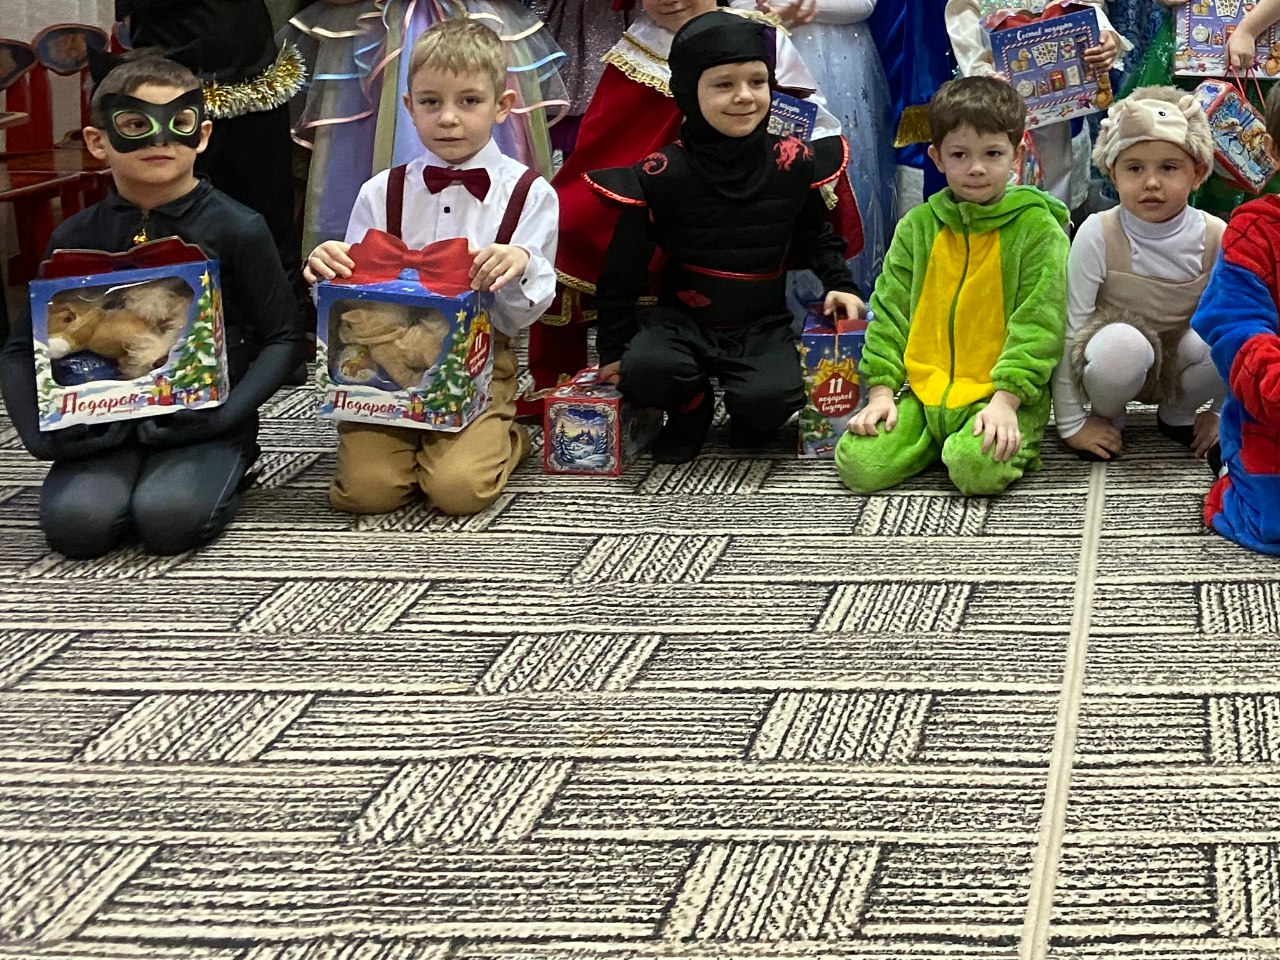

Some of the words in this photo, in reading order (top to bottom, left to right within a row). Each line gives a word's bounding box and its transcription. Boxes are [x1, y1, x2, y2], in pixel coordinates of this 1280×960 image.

[829, 378, 843, 394] 11
[60, 392, 138, 417] Подарок
[333, 390, 397, 414] Подарок
